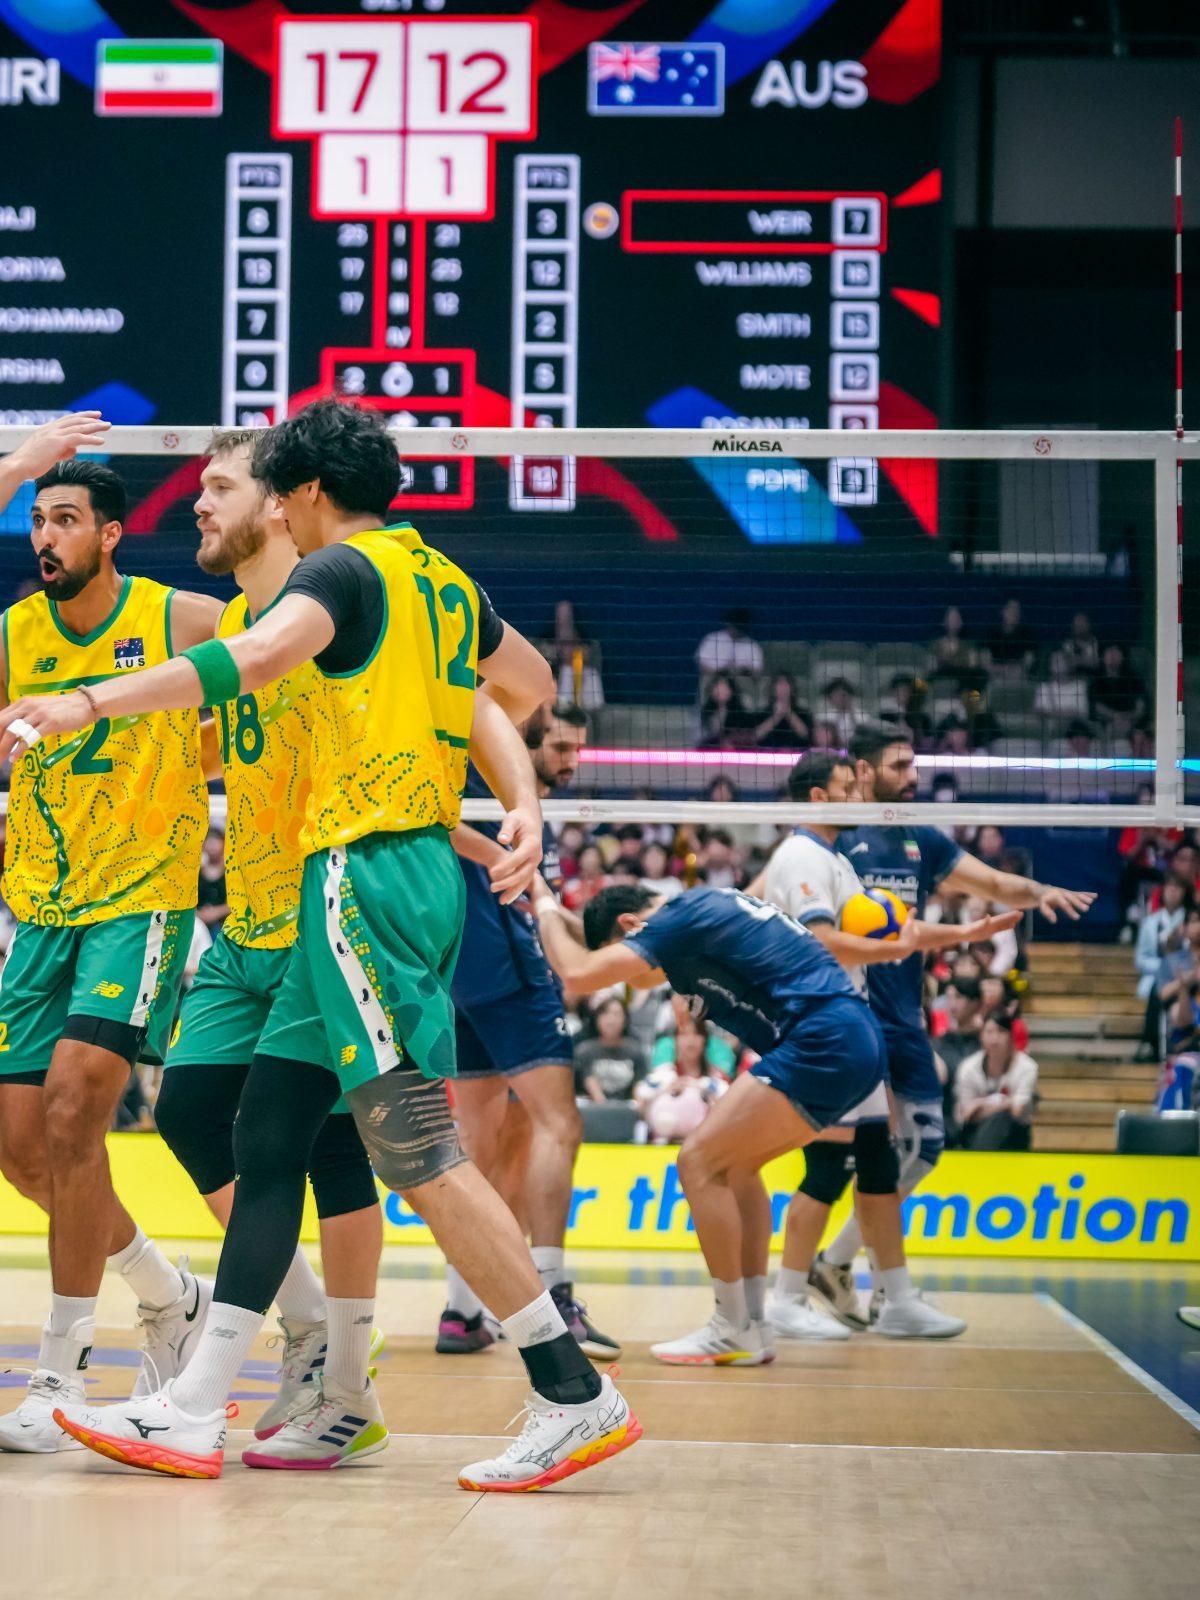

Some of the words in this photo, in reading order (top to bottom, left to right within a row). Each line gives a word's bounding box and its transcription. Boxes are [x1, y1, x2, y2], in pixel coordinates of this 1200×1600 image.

[306, 53, 380, 114] 17
[427, 51, 509, 115] 12
[751, 60, 869, 108] AUS
[356, 156, 369, 196] 1
[440, 156, 453, 197] 1
[535, 208, 557, 235] 3
[747, 210, 813, 235] WEIR
[848, 211, 866, 233] 7
[530, 259, 561, 286] 12
[695, 260, 813, 288] WILLIAMS
[246, 308, 267, 335] 7
[534, 310, 557, 338] 2
[737, 313, 811, 338] SMITH
[740, 364, 811, 390] MOTE
[412, 571, 476, 690] 12
[114, 657, 146, 670] AUS
[216, 693, 265, 765] 18
[70, 716, 113, 775] 2
[45, 1375, 61, 1386] NIKE
